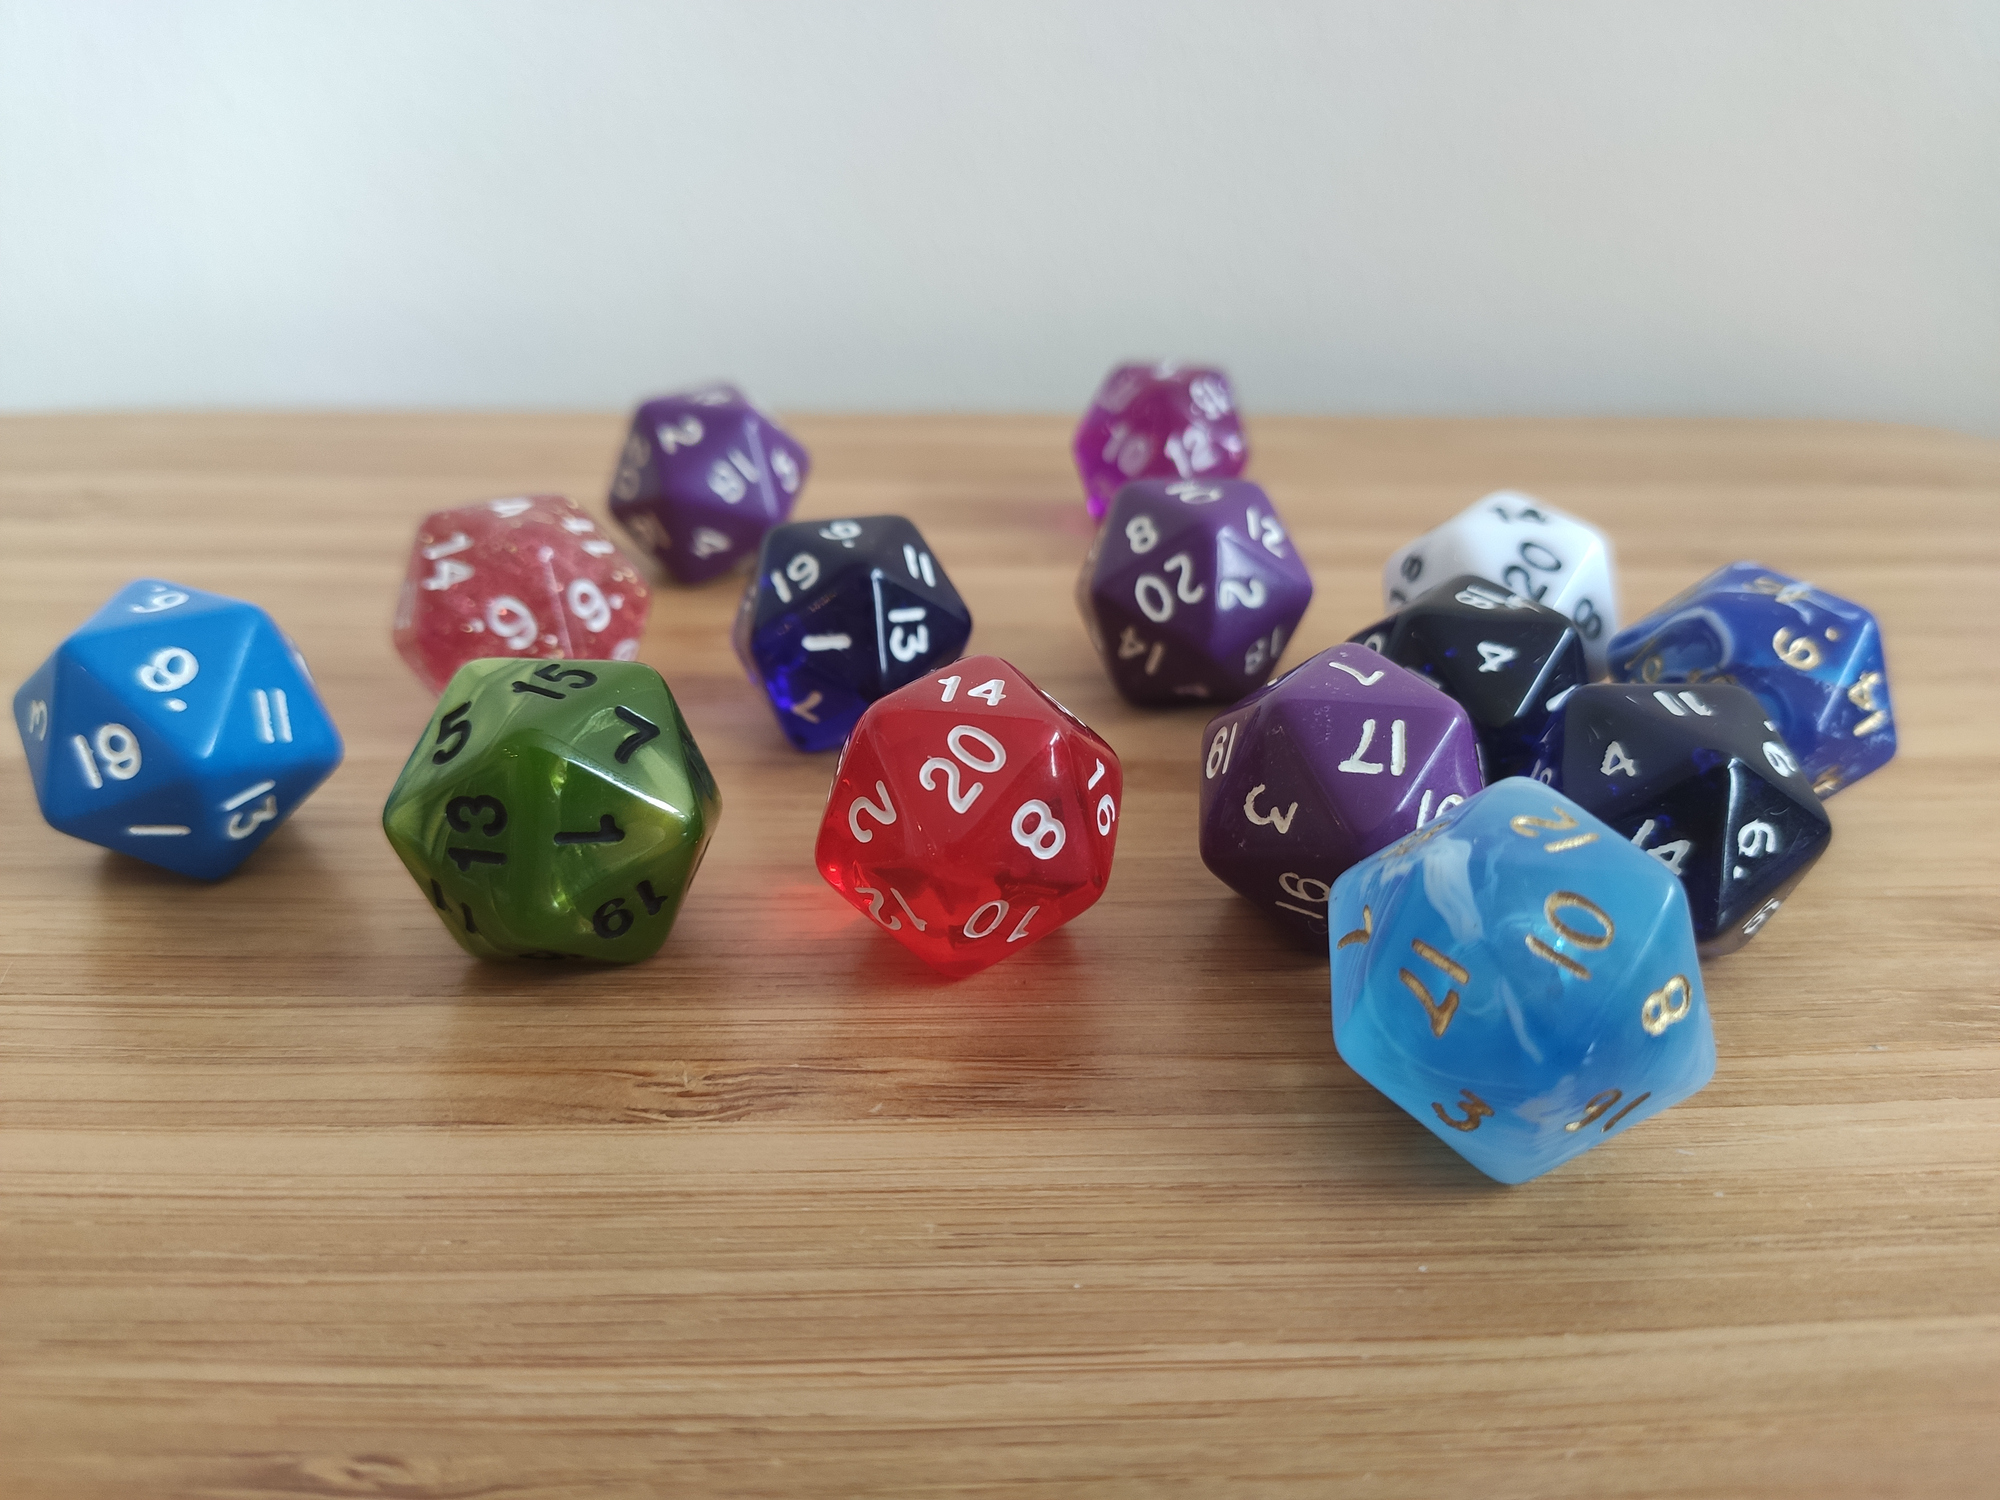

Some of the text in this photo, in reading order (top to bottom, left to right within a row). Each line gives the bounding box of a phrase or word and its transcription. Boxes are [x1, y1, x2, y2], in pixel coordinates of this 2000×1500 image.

[1164, 422, 1218, 479] 12
[1125, 515, 1160, 554] 8
[1246, 506, 1286, 559] 12
[423, 532, 475, 591] 14
[770, 553, 820, 603] 19
[903, 543, 936, 587] 11
[1134, 553, 1206, 623] 20
[1503, 541, 1562, 602] 20
[1218, 578, 1266, 611] 2
[1573, 598, 1601, 641] 8
[801, 633, 852, 652] 1
[888, 607, 929, 663] 13
[1477, 640, 1517, 672] 4
[512, 664, 598, 700] 15
[937, 675, 1006, 706] 14
[1328, 661, 1385, 686] 7
[254, 688, 293, 743] 11
[1653, 690, 1714, 717] 11
[73, 722, 142, 789] 19
[433, 701, 472, 765] 5
[614, 705, 660, 764] 7
[1337, 718, 1406, 777] 17
[1600, 740, 1637, 777] 4
[919, 724, 1007, 814] 20
[223, 780, 277, 839] 13
[848, 780, 897, 844] 2
[1088, 758, 1116, 836] 16
[1243, 783, 1299, 834] 3
[447, 795, 508, 872] 13
[554, 814, 625, 845] 1
[1011, 799, 1066, 860] 8
[1510, 806, 1599, 853] 12
[593, 880, 668, 939] 19
[854, 887, 927, 932] 12
[963, 900, 1040, 943] 10
[1336, 904, 1373, 950] 7
[1525, 890, 1615, 980] 10
[1399, 938, 1470, 1038] 17
[1642, 974, 1693, 1036] 8
[1431, 1089, 1495, 1132] 3
